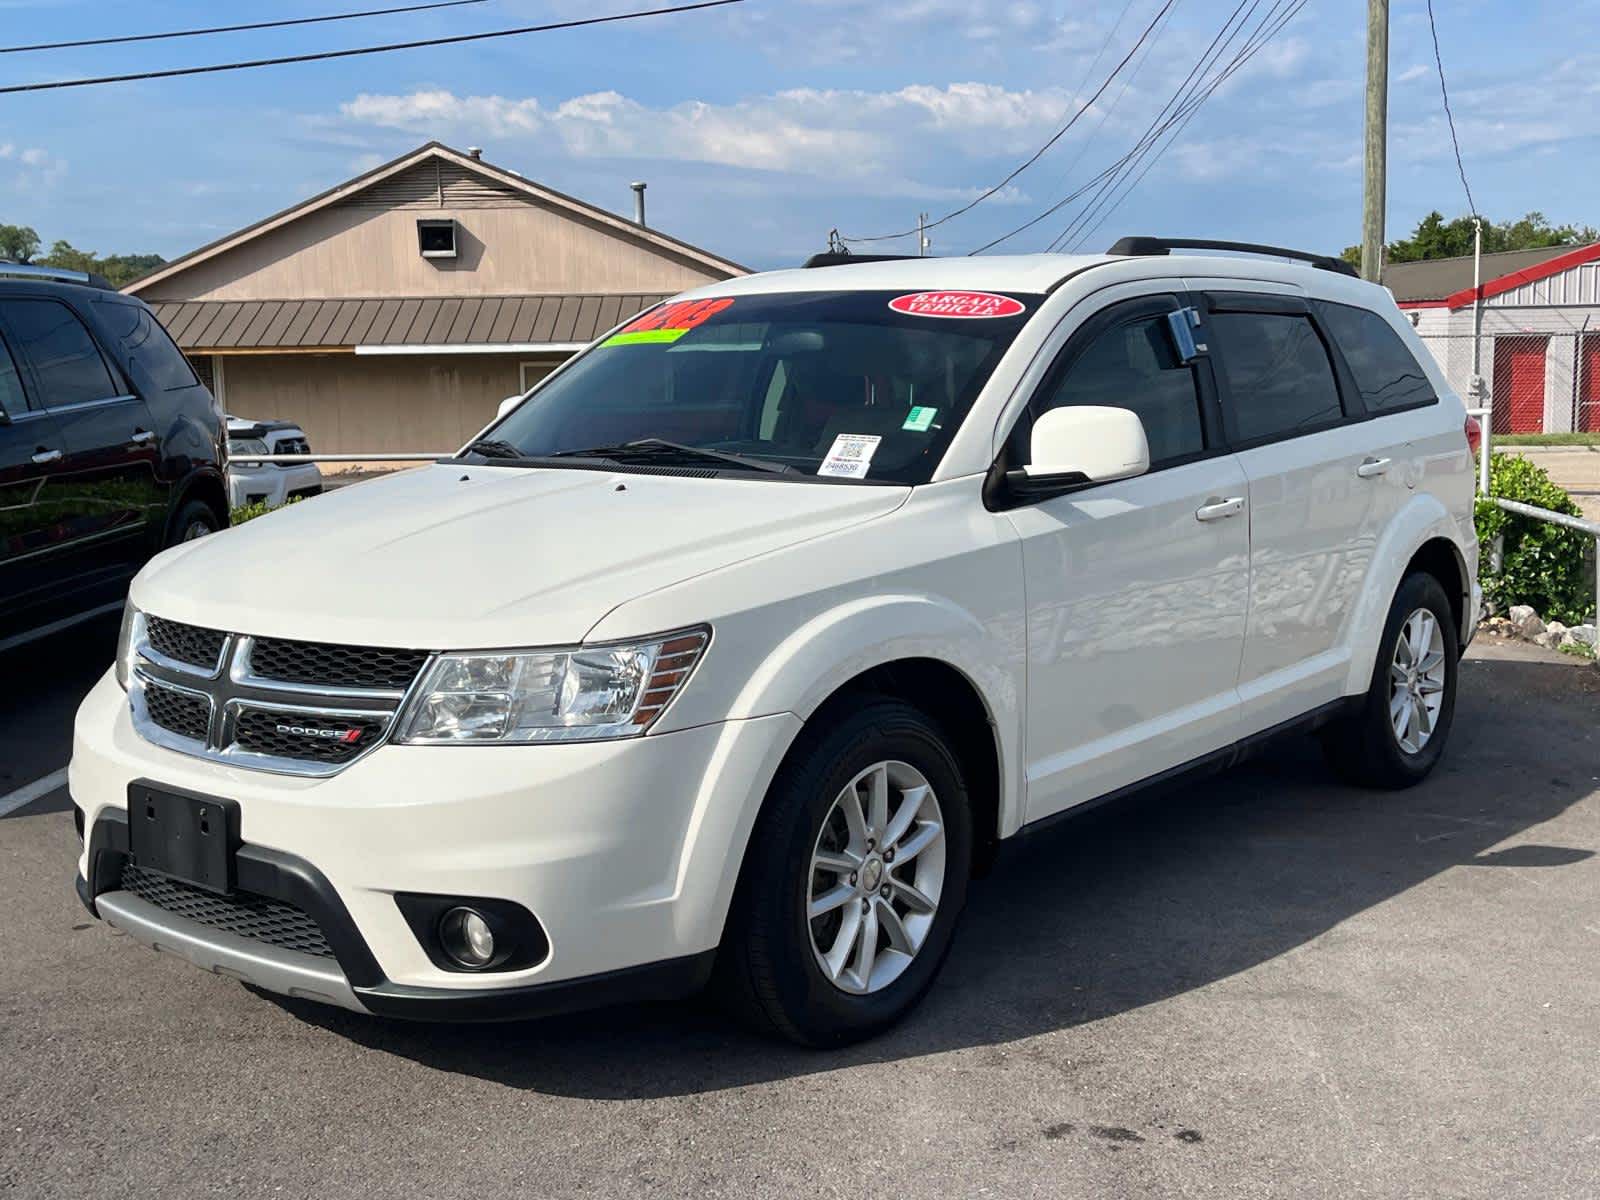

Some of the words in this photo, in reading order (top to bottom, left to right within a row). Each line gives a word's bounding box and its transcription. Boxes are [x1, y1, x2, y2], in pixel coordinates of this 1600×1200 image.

[912, 294, 1004, 306] BARGAIN
[907, 303, 999, 315] VEHICLE
[276, 724, 347, 738] DODGE
